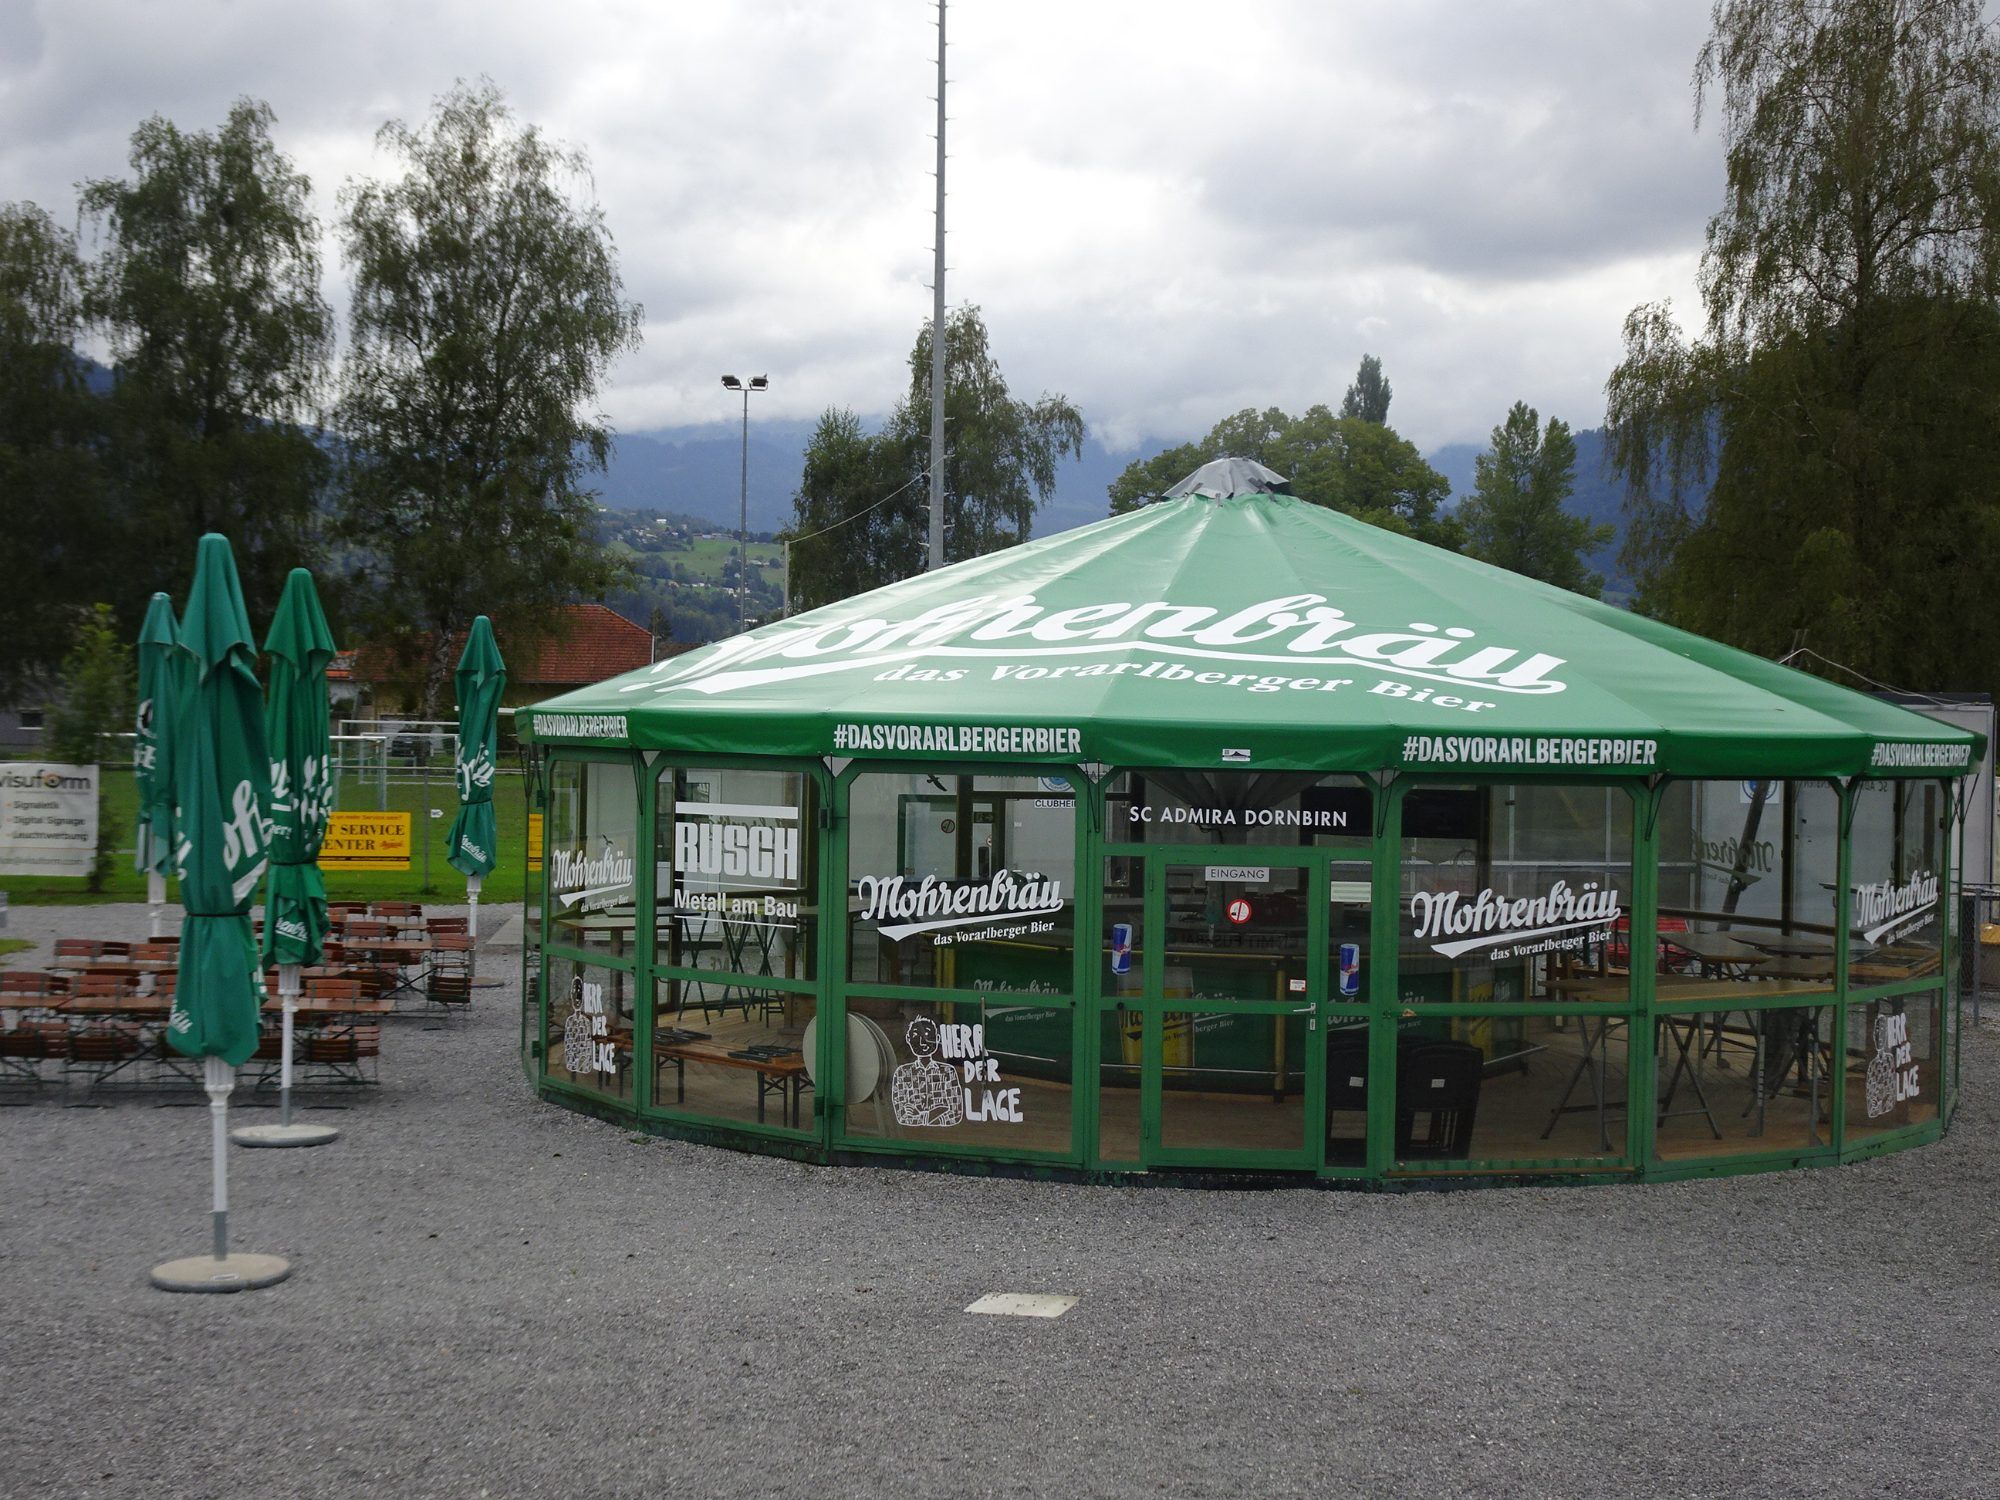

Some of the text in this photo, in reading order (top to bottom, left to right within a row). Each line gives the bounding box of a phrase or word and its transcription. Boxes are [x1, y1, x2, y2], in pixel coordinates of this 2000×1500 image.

[873, 661, 1496, 713] das Vorarlberger Bier
[533, 714, 628, 738] #DASVORARLBERGERBIER
[834, 724, 1082, 753] #DASVORARLBERGERBIER
[1402, 736, 1657, 765] #DASVORARLBERGERBIER
[1035, 800, 1077, 809] CLUBHEI
[1129, 806, 1347, 827] SC ADMIRA DORNBIRN
[320, 839, 375, 850] ENTER
[341, 825, 405, 836] SERVICE
[674, 822, 798, 880] RUSCH
[553, 846, 632, 888] Mohrenbräu
[1210, 868, 1265, 880] EINGANG
[674, 889, 797, 918] Metall am Bau
[858, 869, 1064, 920] Mohrenbräu
[1411, 880, 1621, 938] Mohrenbräu
[1856, 870, 1938, 927] Mohrenbräu
[933, 921, 1054, 946] das Vorarlberger Bier
[1490, 930, 1612, 960] das Vorarlberger Bier
[939, 1024, 989, 1058] HERR
[964, 1058, 1001, 1083] DER
[965, 1087, 1024, 1123] LAGE
